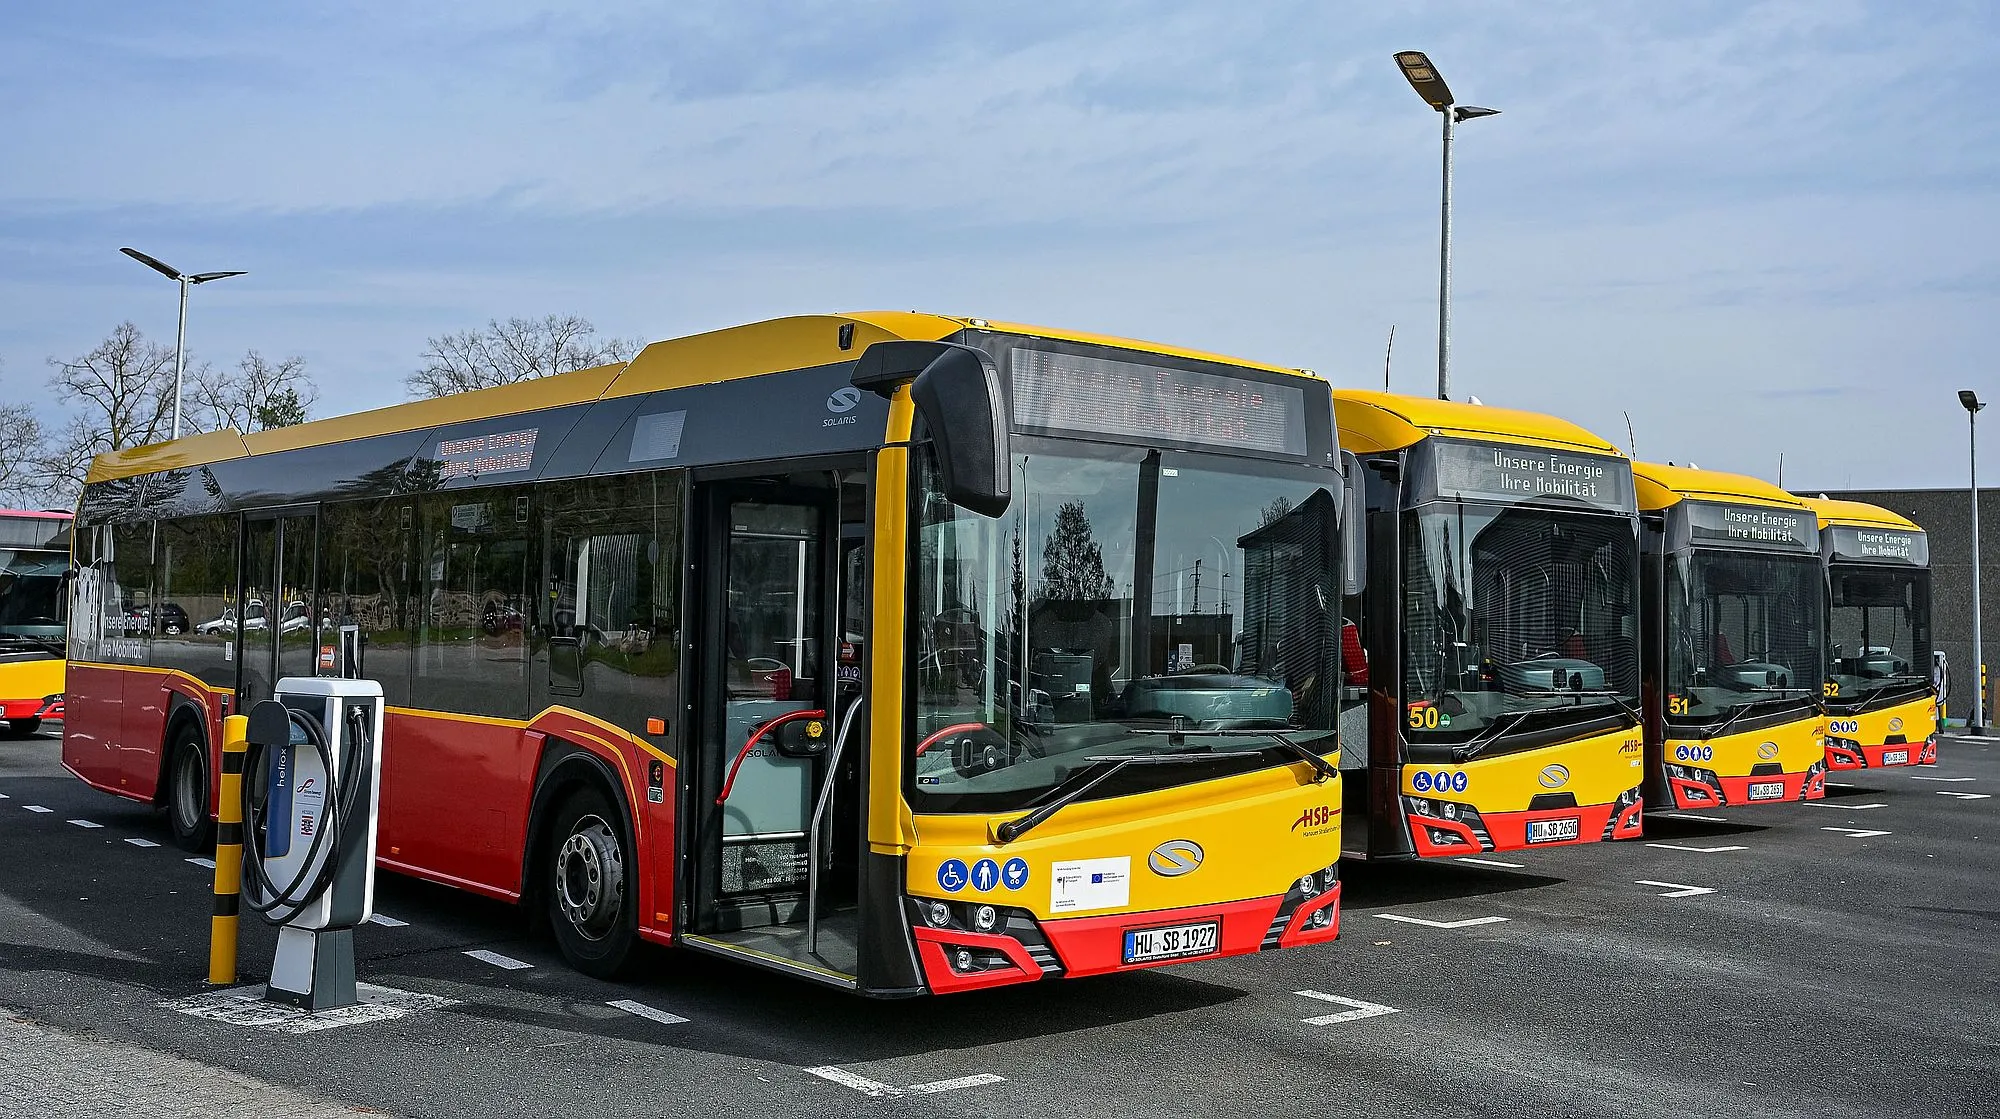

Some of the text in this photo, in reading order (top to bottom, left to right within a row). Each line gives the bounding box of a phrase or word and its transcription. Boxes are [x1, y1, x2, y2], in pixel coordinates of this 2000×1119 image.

[1156, 371, 1264, 410] Energie
[822, 415, 857, 427] SOLARIS
[441, 438, 484, 456] Unsere
[1550, 454, 1603, 480] Energie
[1501, 472, 1597, 497] Ihre Mobilität
[1724, 508, 1797, 529] Unsere Energie
[1728, 524, 1793, 542] Ihre Mobilität
[1857, 531, 1883, 543] Unsere
[1861, 543, 1877, 555] Ihre
[1823, 683, 1839, 697] 52
[1669, 697, 1688, 715] 51
[1409, 706, 1438, 729] 50
[276, 748, 287, 787] heliox
[1752, 786, 1760, 796] HU
[1302, 806, 1329, 827] HSB
[1532, 823, 1543, 838] HU
[1547, 822, 1558, 837] SB
[1135, 926, 1215, 955] HU SB 1927
